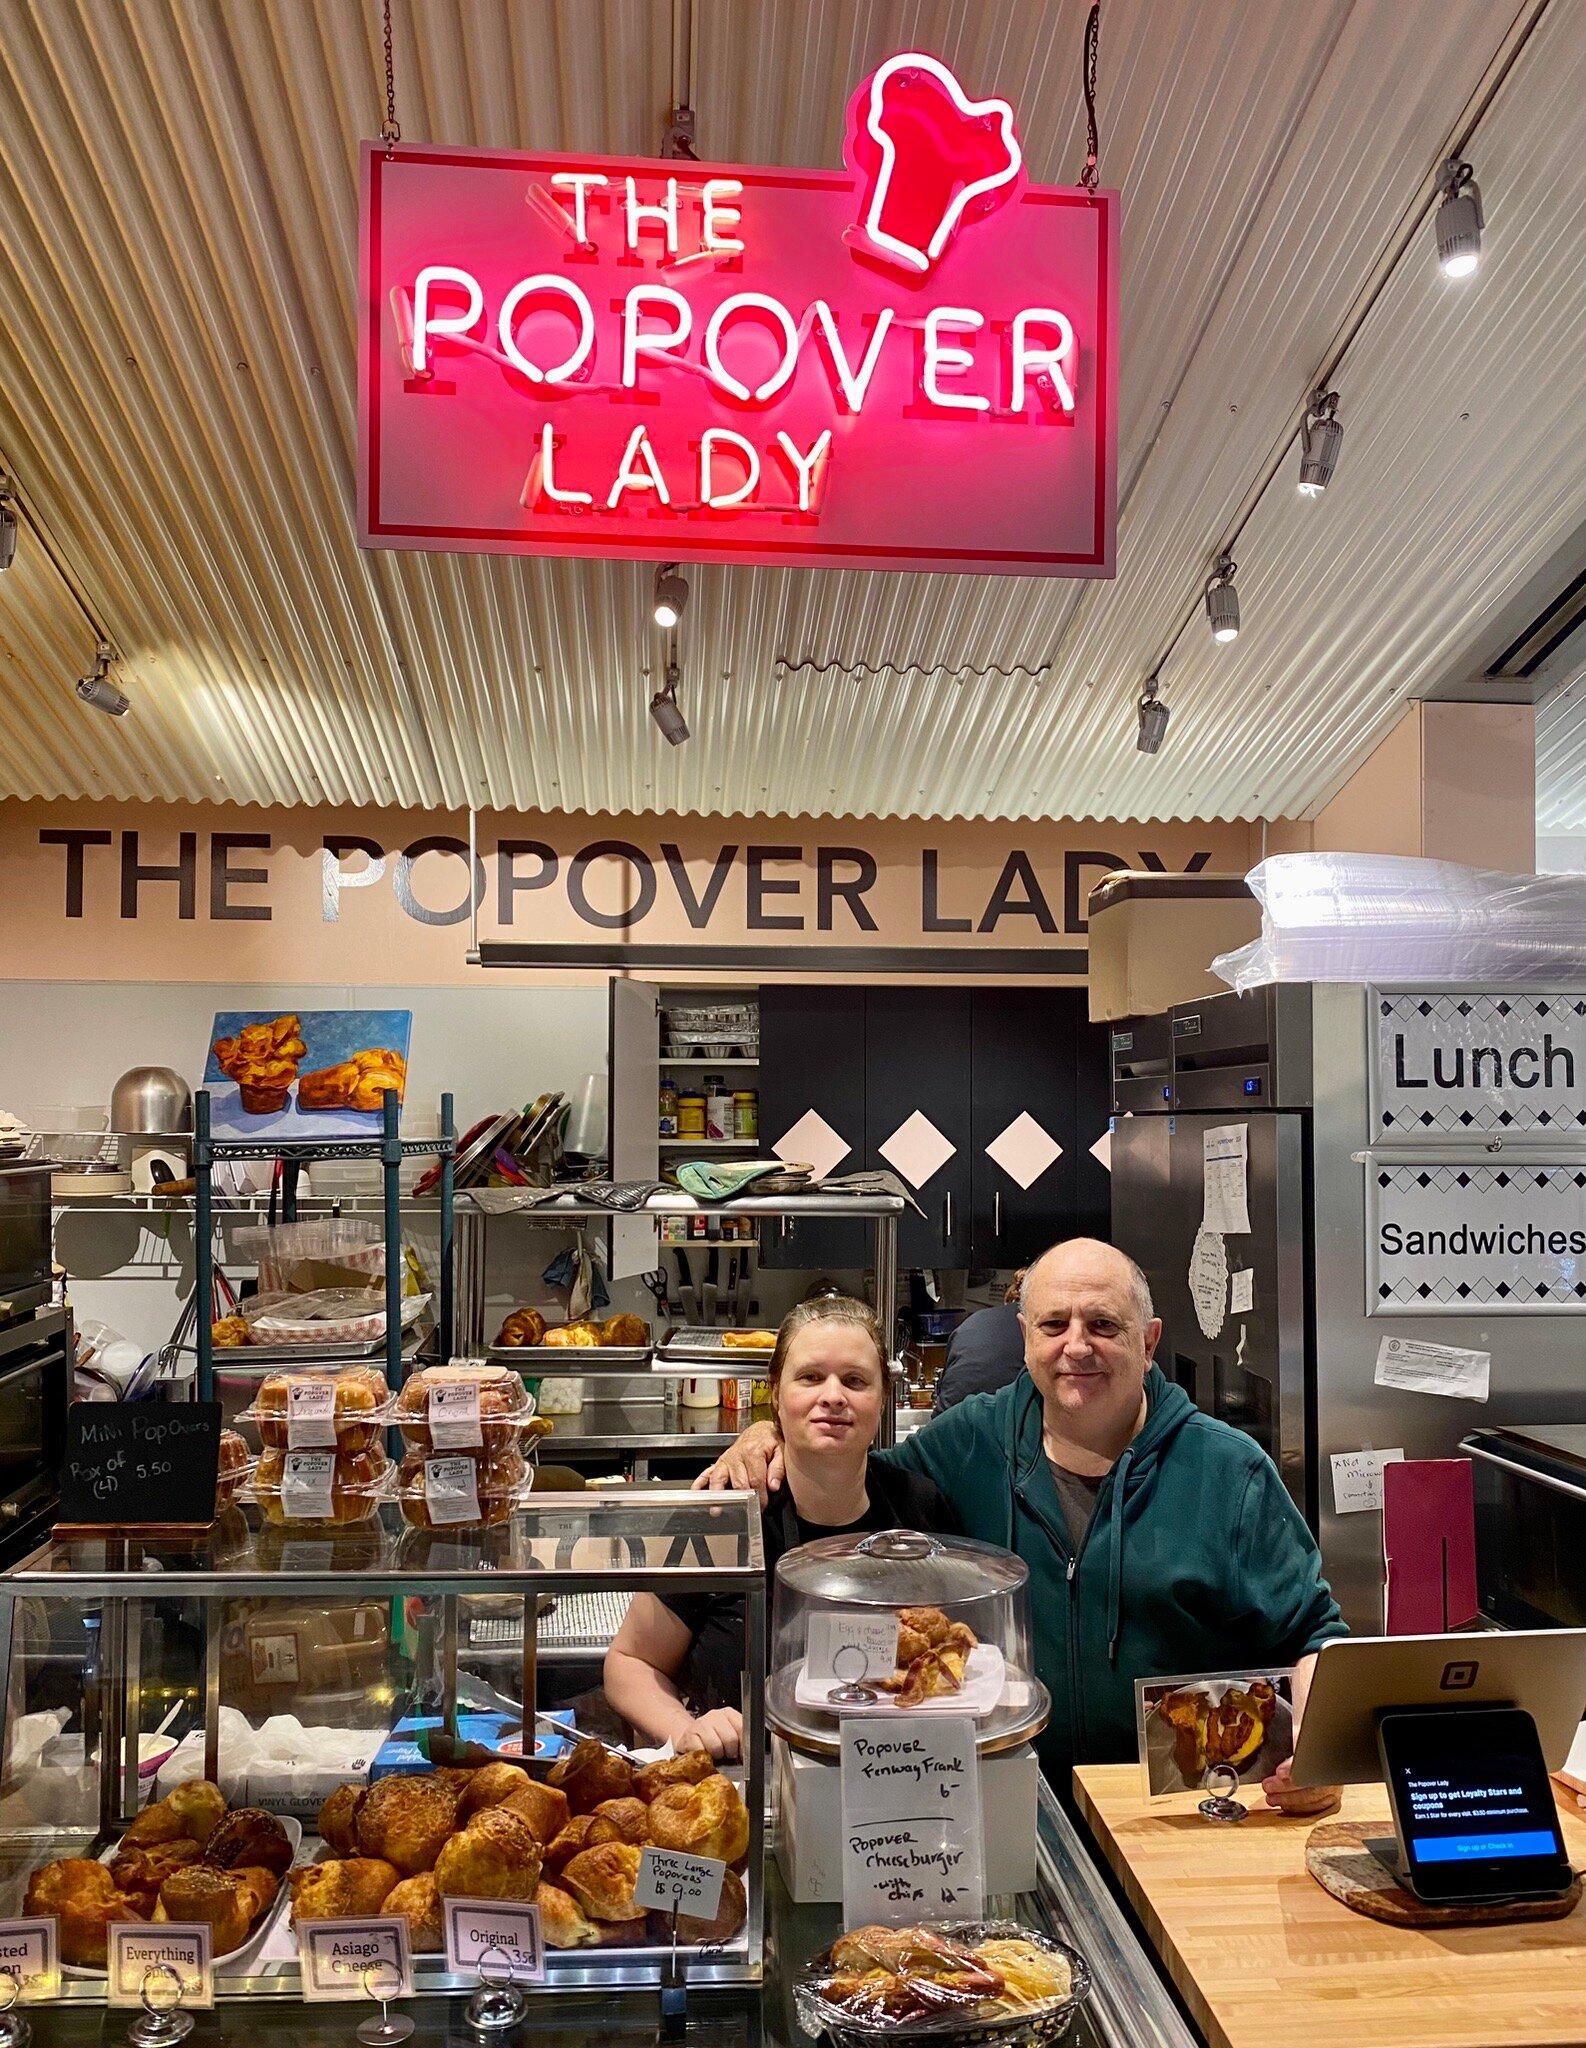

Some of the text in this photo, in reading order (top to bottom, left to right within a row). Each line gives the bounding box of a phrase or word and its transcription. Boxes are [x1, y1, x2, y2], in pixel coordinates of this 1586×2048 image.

[551, 172, 745, 252] THE
[413, 266, 1075, 412] POPOVER
[543, 422, 832, 511] LADY
[39, 829, 1211, 934] THE POPOVER LAD
[1395, 1034, 1574, 1089] Lunch
[1380, 1223, 1586, 1255] Sandwiches
[136, 1461, 171, 1479] 5.50
[861, 1757, 964, 1781] Fenway Frank
[258, 1798, 290, 1807] VINYL
[1411, 1792, 1428, 1801] Sign
[1439, 1791, 1447, 1799] to
[1448, 1791, 1460, 1800] get
[1461, 1789, 1486, 1798] Loyalty
[1487, 1788, 1507, 1796] Stars
[1508, 1787, 1522, 1795] and
[1413, 1802, 1443, 1811] coupons
[648, 1854, 713, 1877] Three Large
[332, 1942, 380, 1957] Asiago
[470, 1929, 518, 1947] Original
[126, 1946, 194, 1964] Everything
